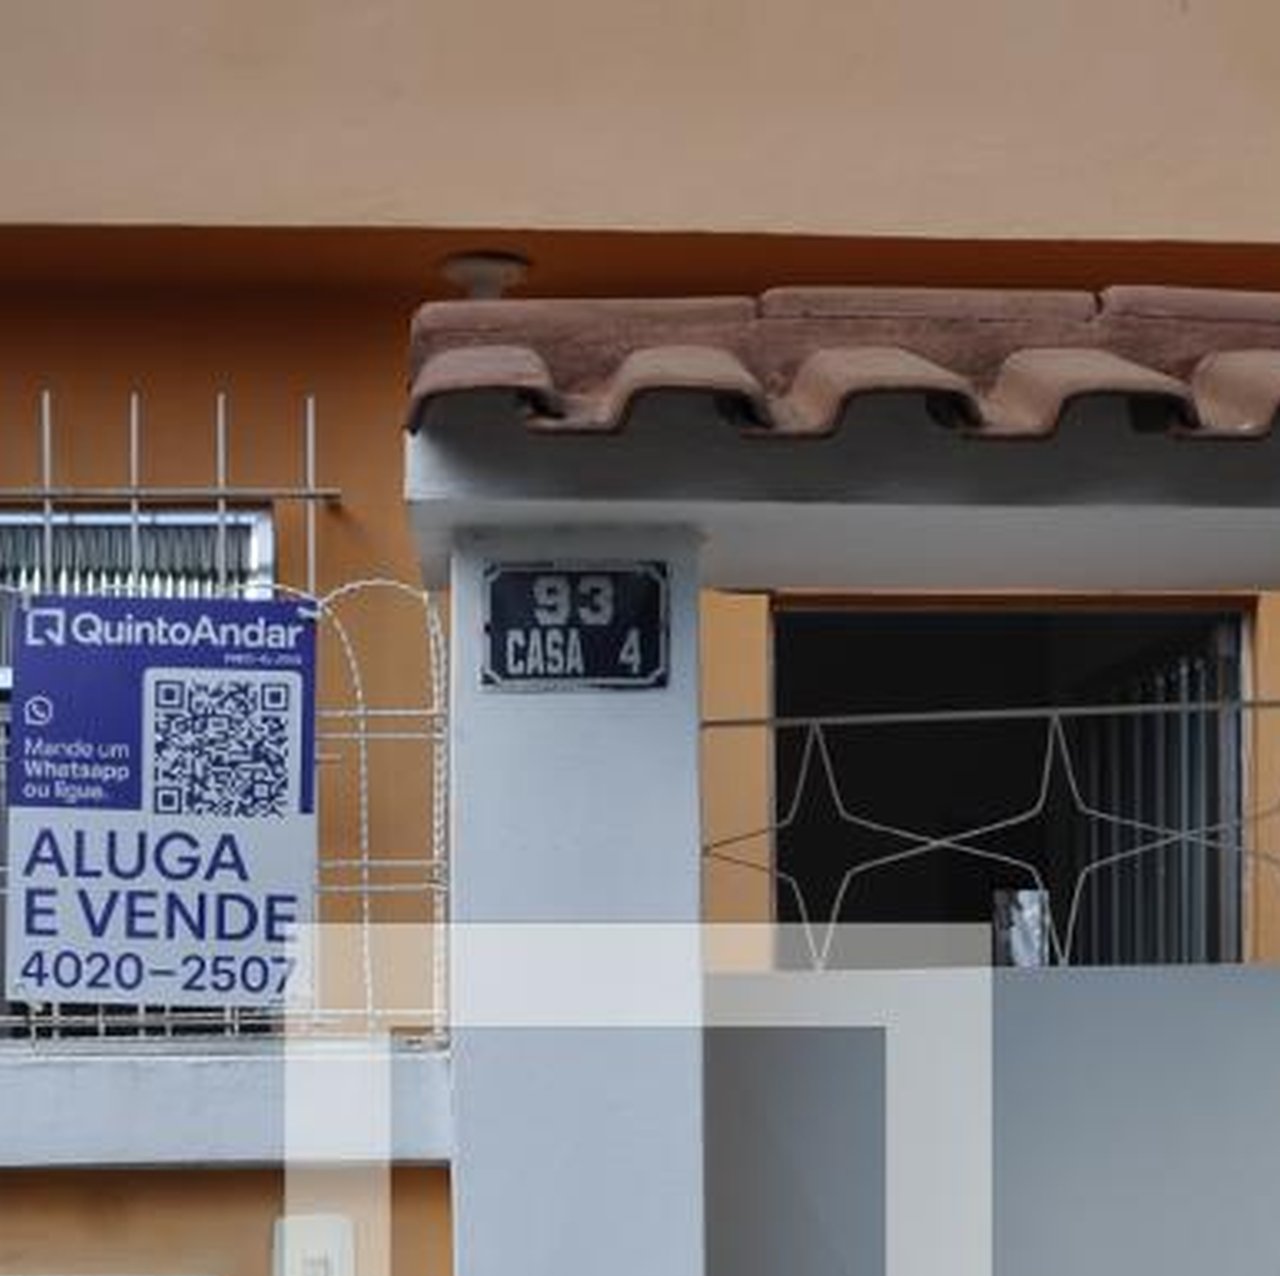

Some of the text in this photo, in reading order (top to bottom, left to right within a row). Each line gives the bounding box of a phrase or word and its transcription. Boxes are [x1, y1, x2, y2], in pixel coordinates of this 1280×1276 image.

[533, 575, 614, 626] 93
[71, 612, 304, 648] QuintoAndar
[506, 628, 642, 675] CASA 4
[24, 737, 130, 759] Mande um
[22, 783, 50, 798] ou
[24, 760, 130, 782] Whatsapp
[23, 828, 249, 882] ALUGA
[24, 888, 298, 943] E VENDE
[21, 950, 298, 994] 4020-2507
